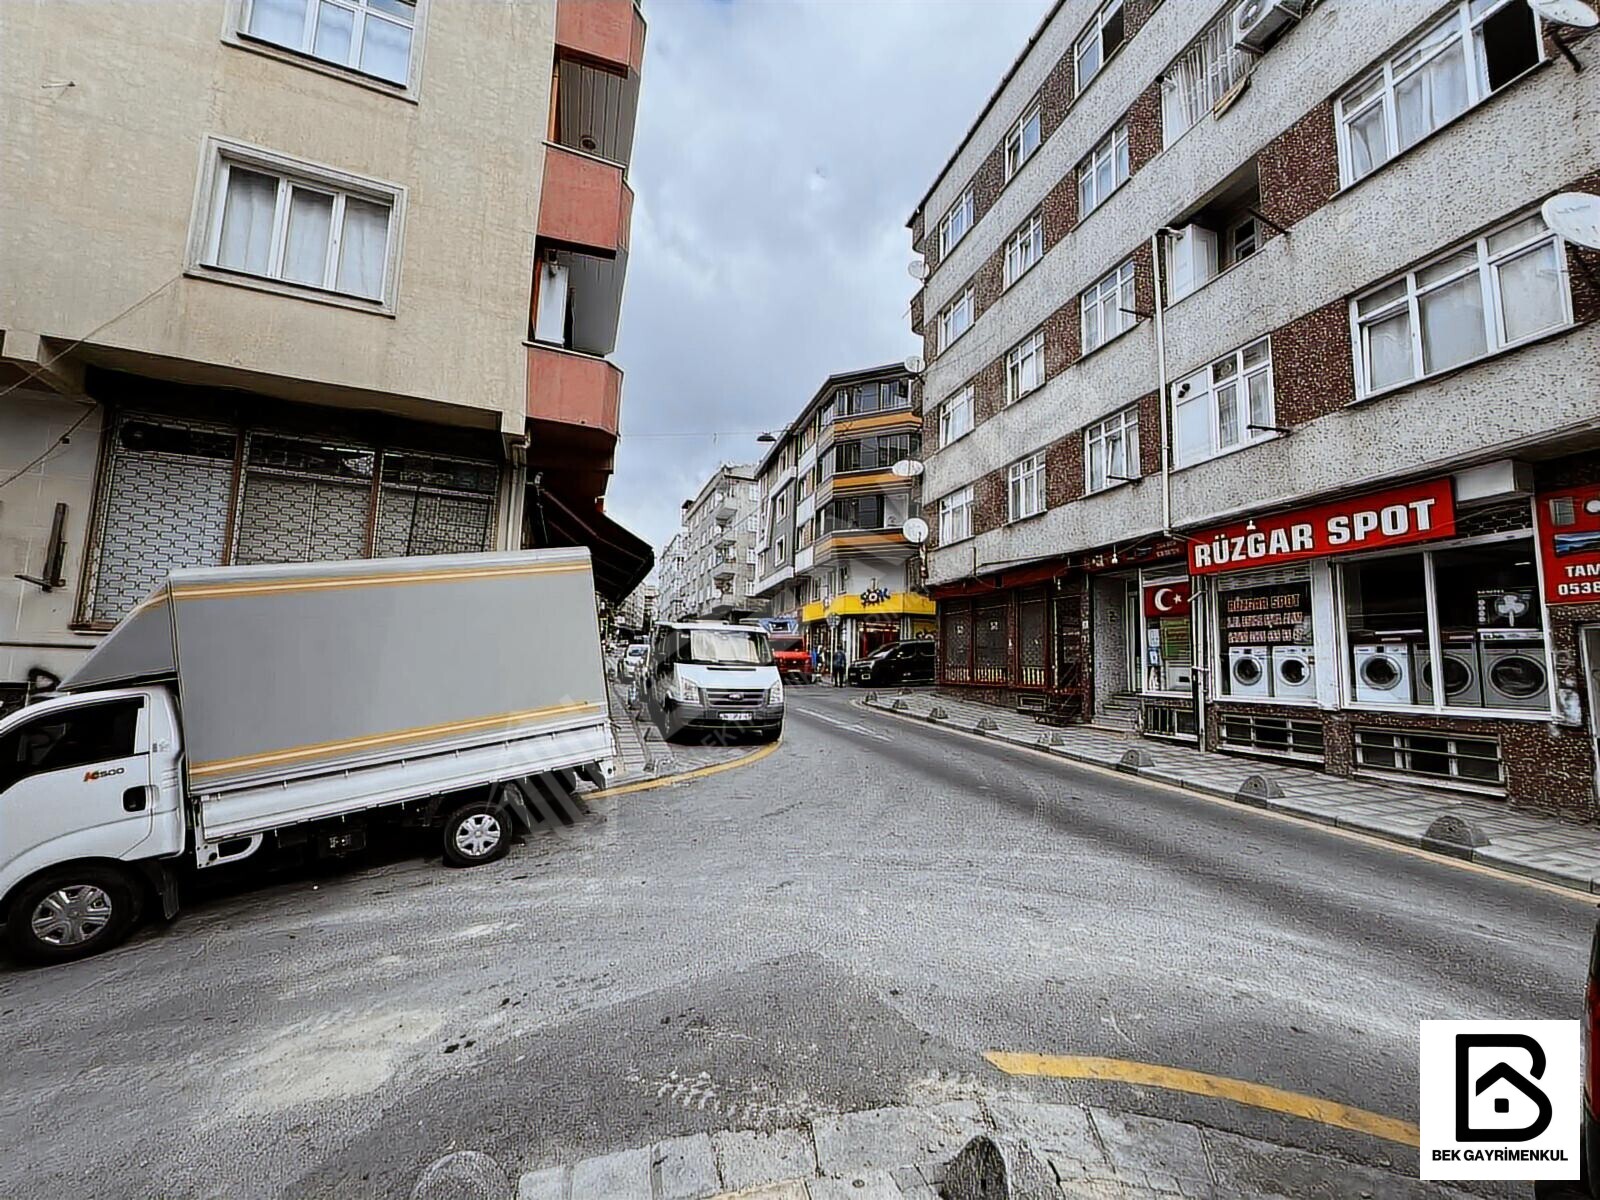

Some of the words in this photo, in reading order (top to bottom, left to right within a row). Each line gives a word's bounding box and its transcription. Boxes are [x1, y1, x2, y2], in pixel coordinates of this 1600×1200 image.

[1194, 524, 1314, 568] RÜZGAR
[1327, 498, 1435, 545] SPOT
[1270, 594, 1300, 609] SPOT
